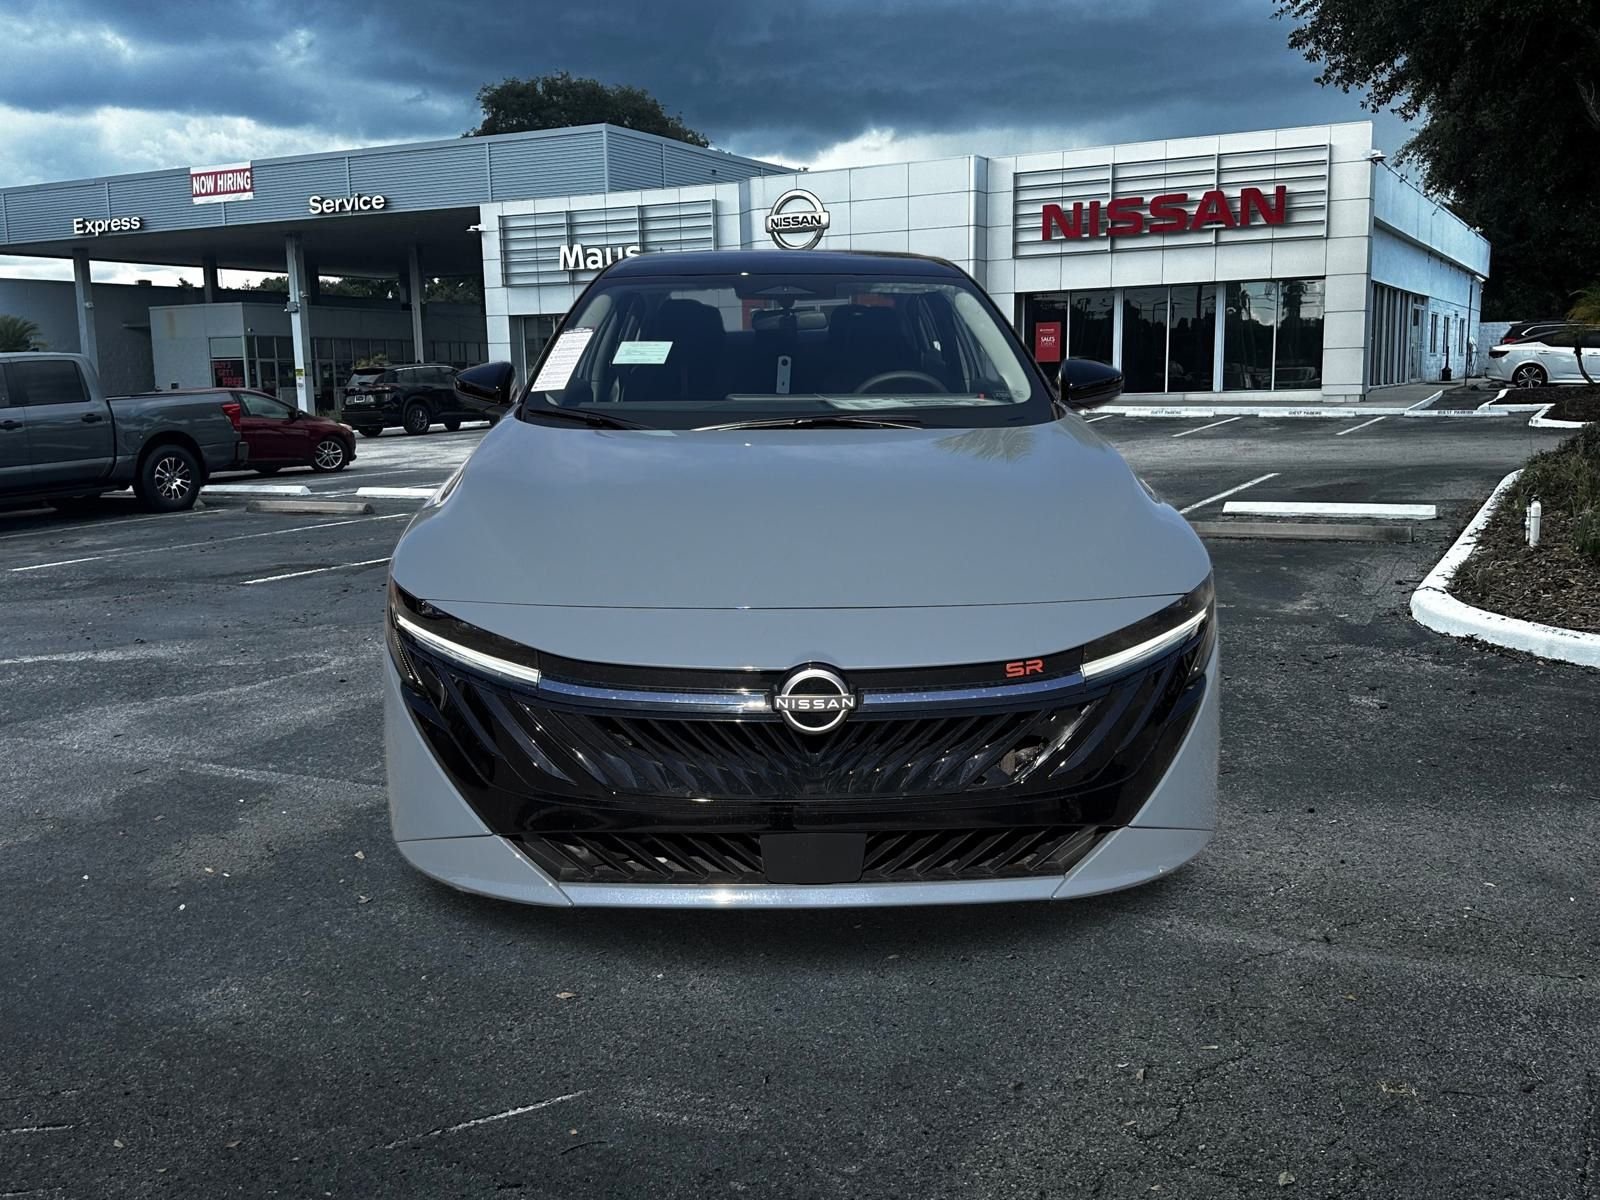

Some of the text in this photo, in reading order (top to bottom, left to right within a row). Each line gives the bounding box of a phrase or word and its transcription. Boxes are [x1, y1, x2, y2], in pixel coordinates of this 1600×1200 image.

[192, 171, 251, 195] NOW HIRING
[308, 193, 385, 214] Service
[1041, 185, 1287, 241] NISSAN
[73, 216, 141, 236] Express
[770, 213, 822, 229] NISSAN
[1005, 659, 1044, 678] SR
[776, 697, 854, 710] NISSAN
